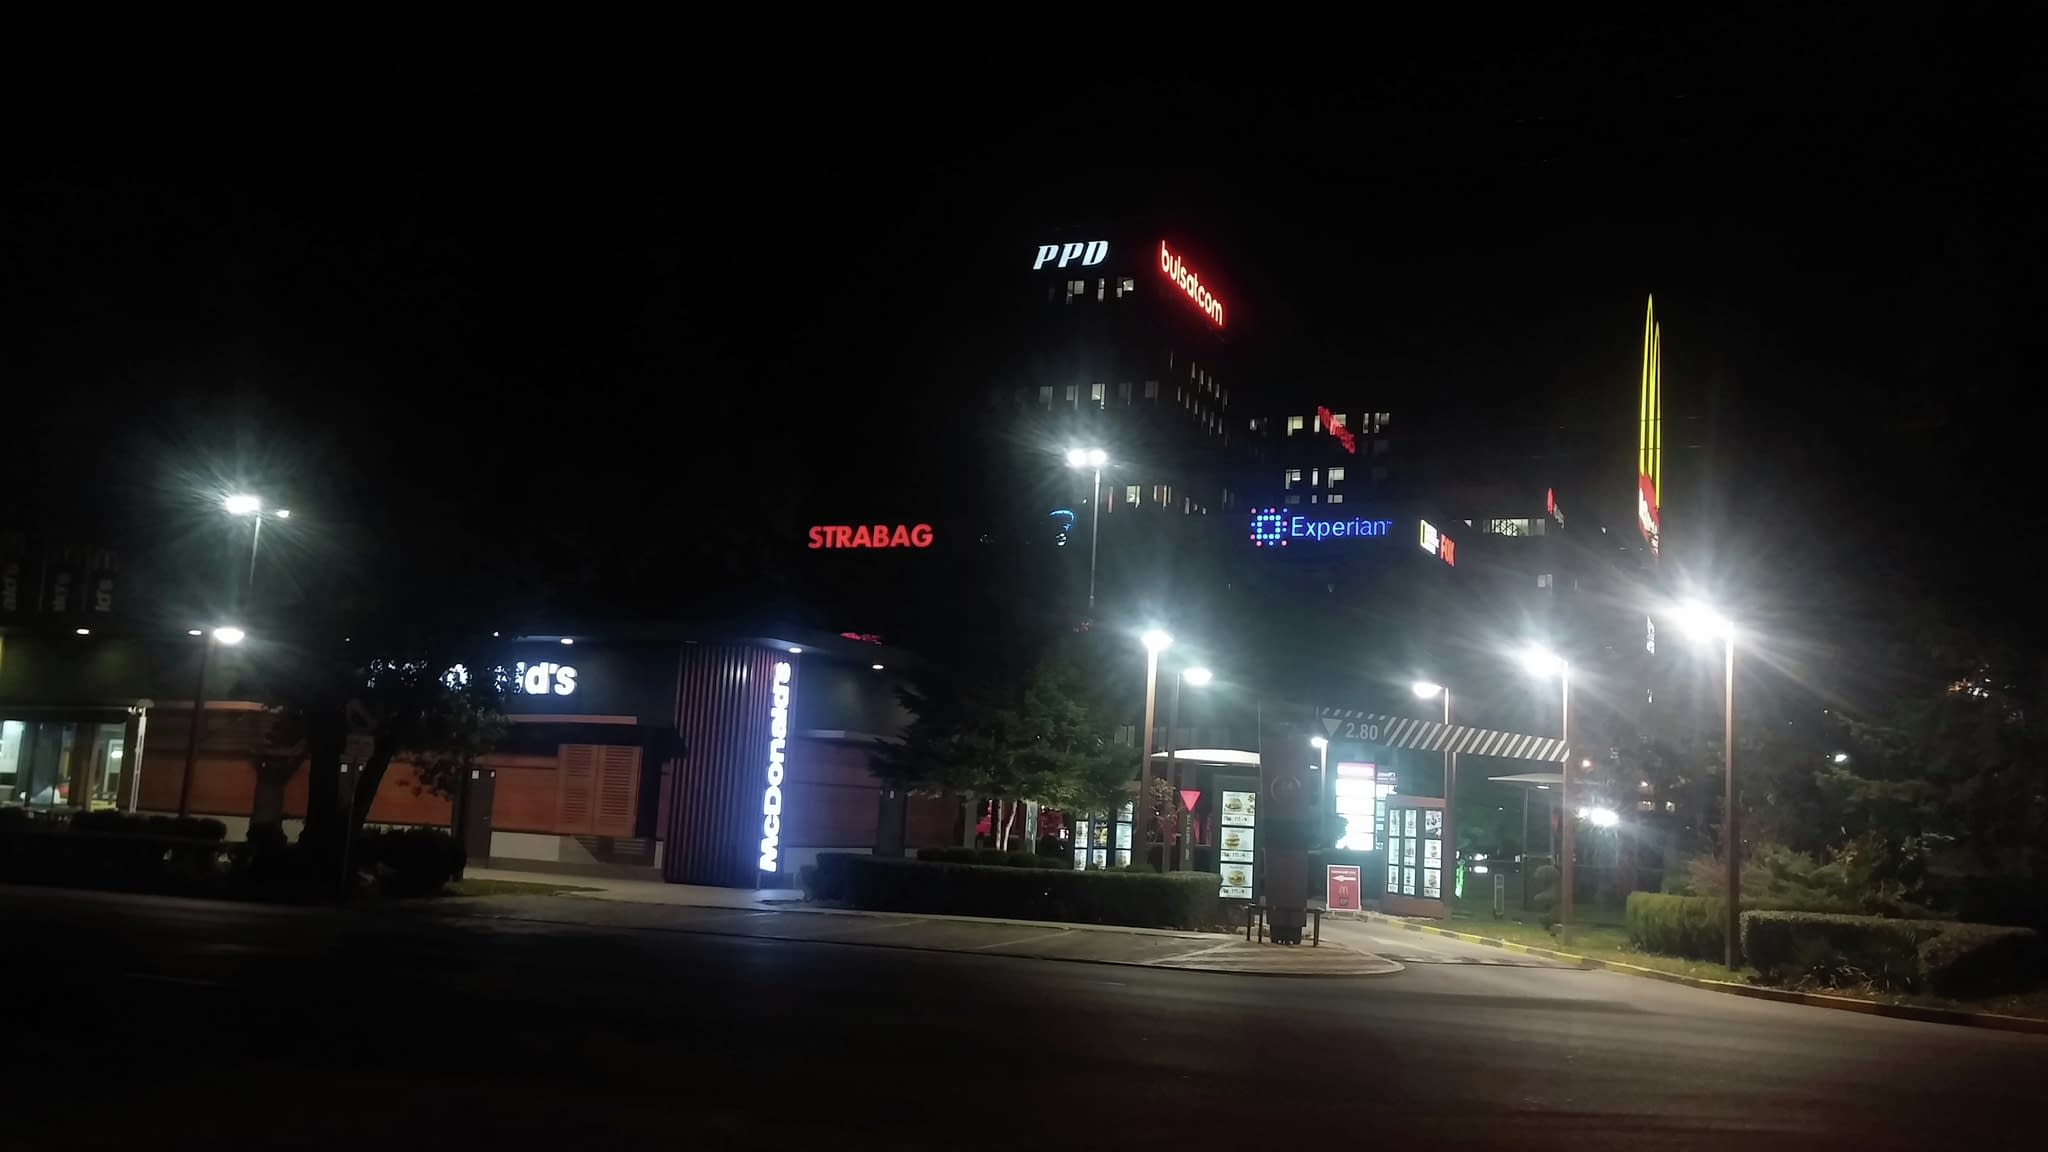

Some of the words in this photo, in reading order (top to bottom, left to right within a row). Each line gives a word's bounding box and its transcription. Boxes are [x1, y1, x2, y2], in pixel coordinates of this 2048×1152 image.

[1033, 240, 1109, 270] PPD
[1161, 239, 1223, 326] bulsatcom
[808, 523, 934, 549] STRABAG
[1345, 722, 1379, 741] 2.80
[759, 661, 792, 873] McDonald's
